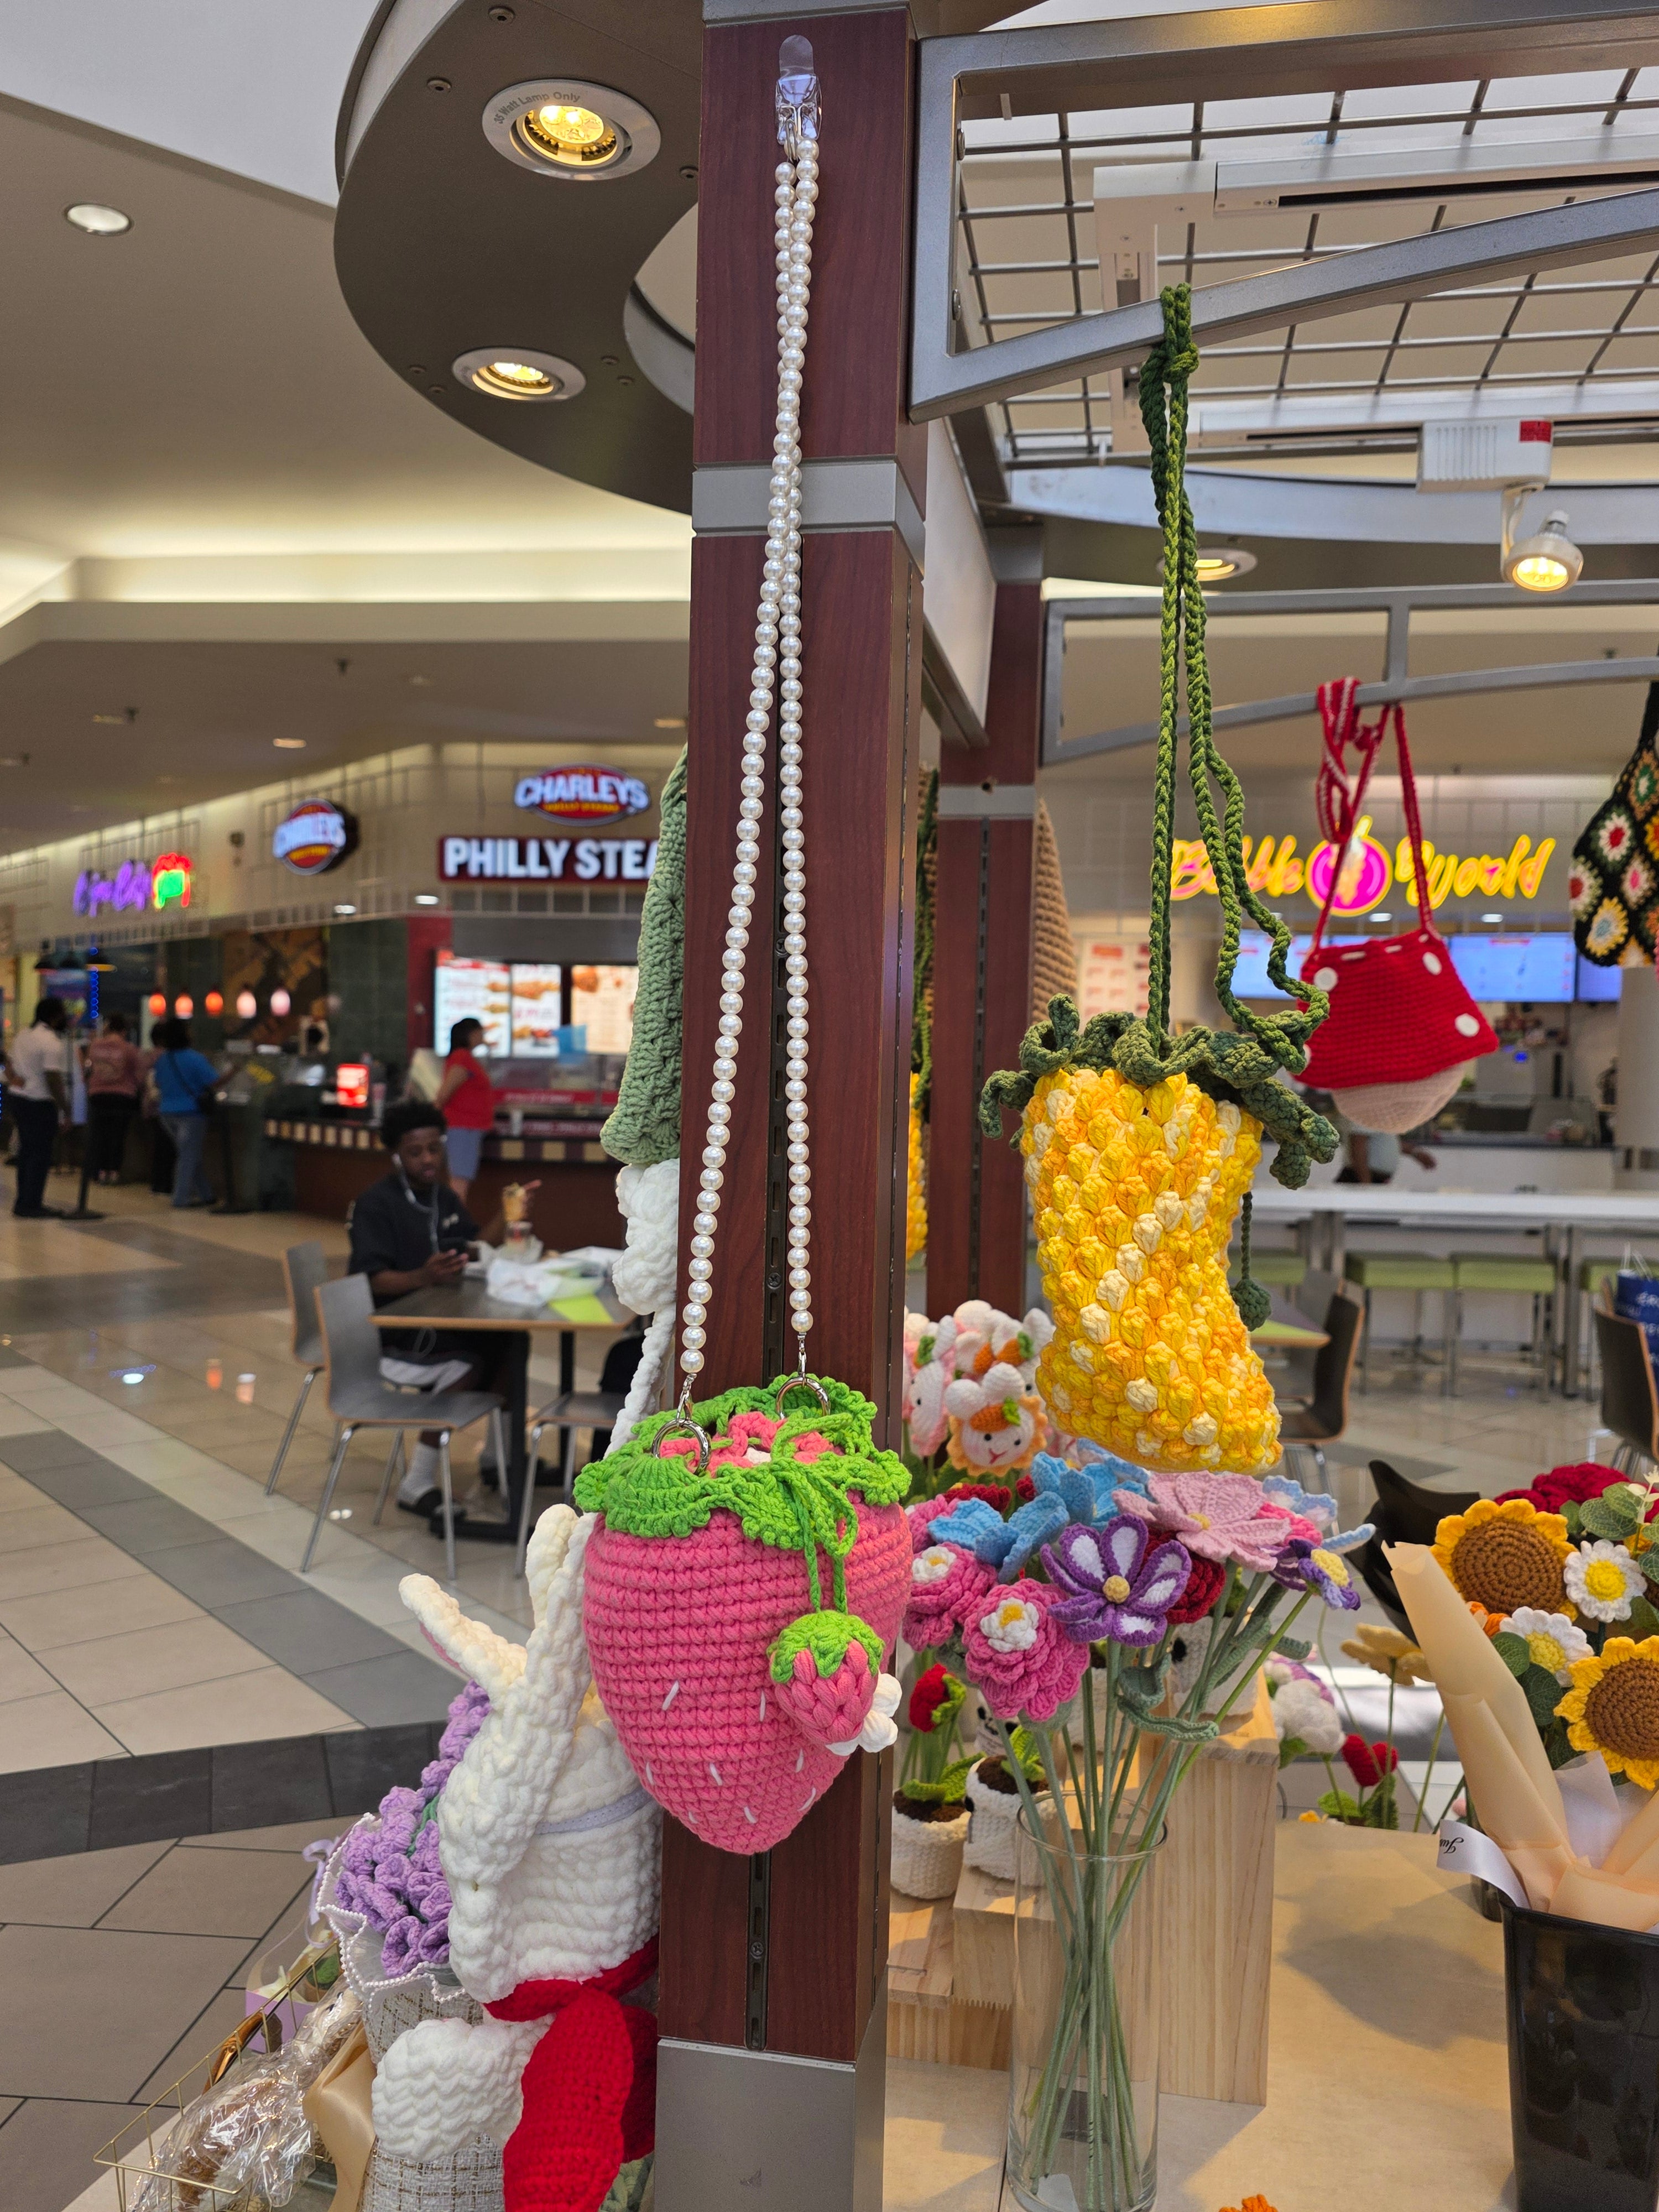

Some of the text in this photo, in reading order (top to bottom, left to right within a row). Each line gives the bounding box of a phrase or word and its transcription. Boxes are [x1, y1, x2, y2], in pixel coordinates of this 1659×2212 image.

[498, 100, 521, 116] Watt
[518, 93, 550, 105] Lamp
[553, 91, 581, 103] Only
[514, 773, 649, 808] CHARLEYS
[444, 837, 572, 878] PHILLY
[1394, 834, 1557, 910] World
